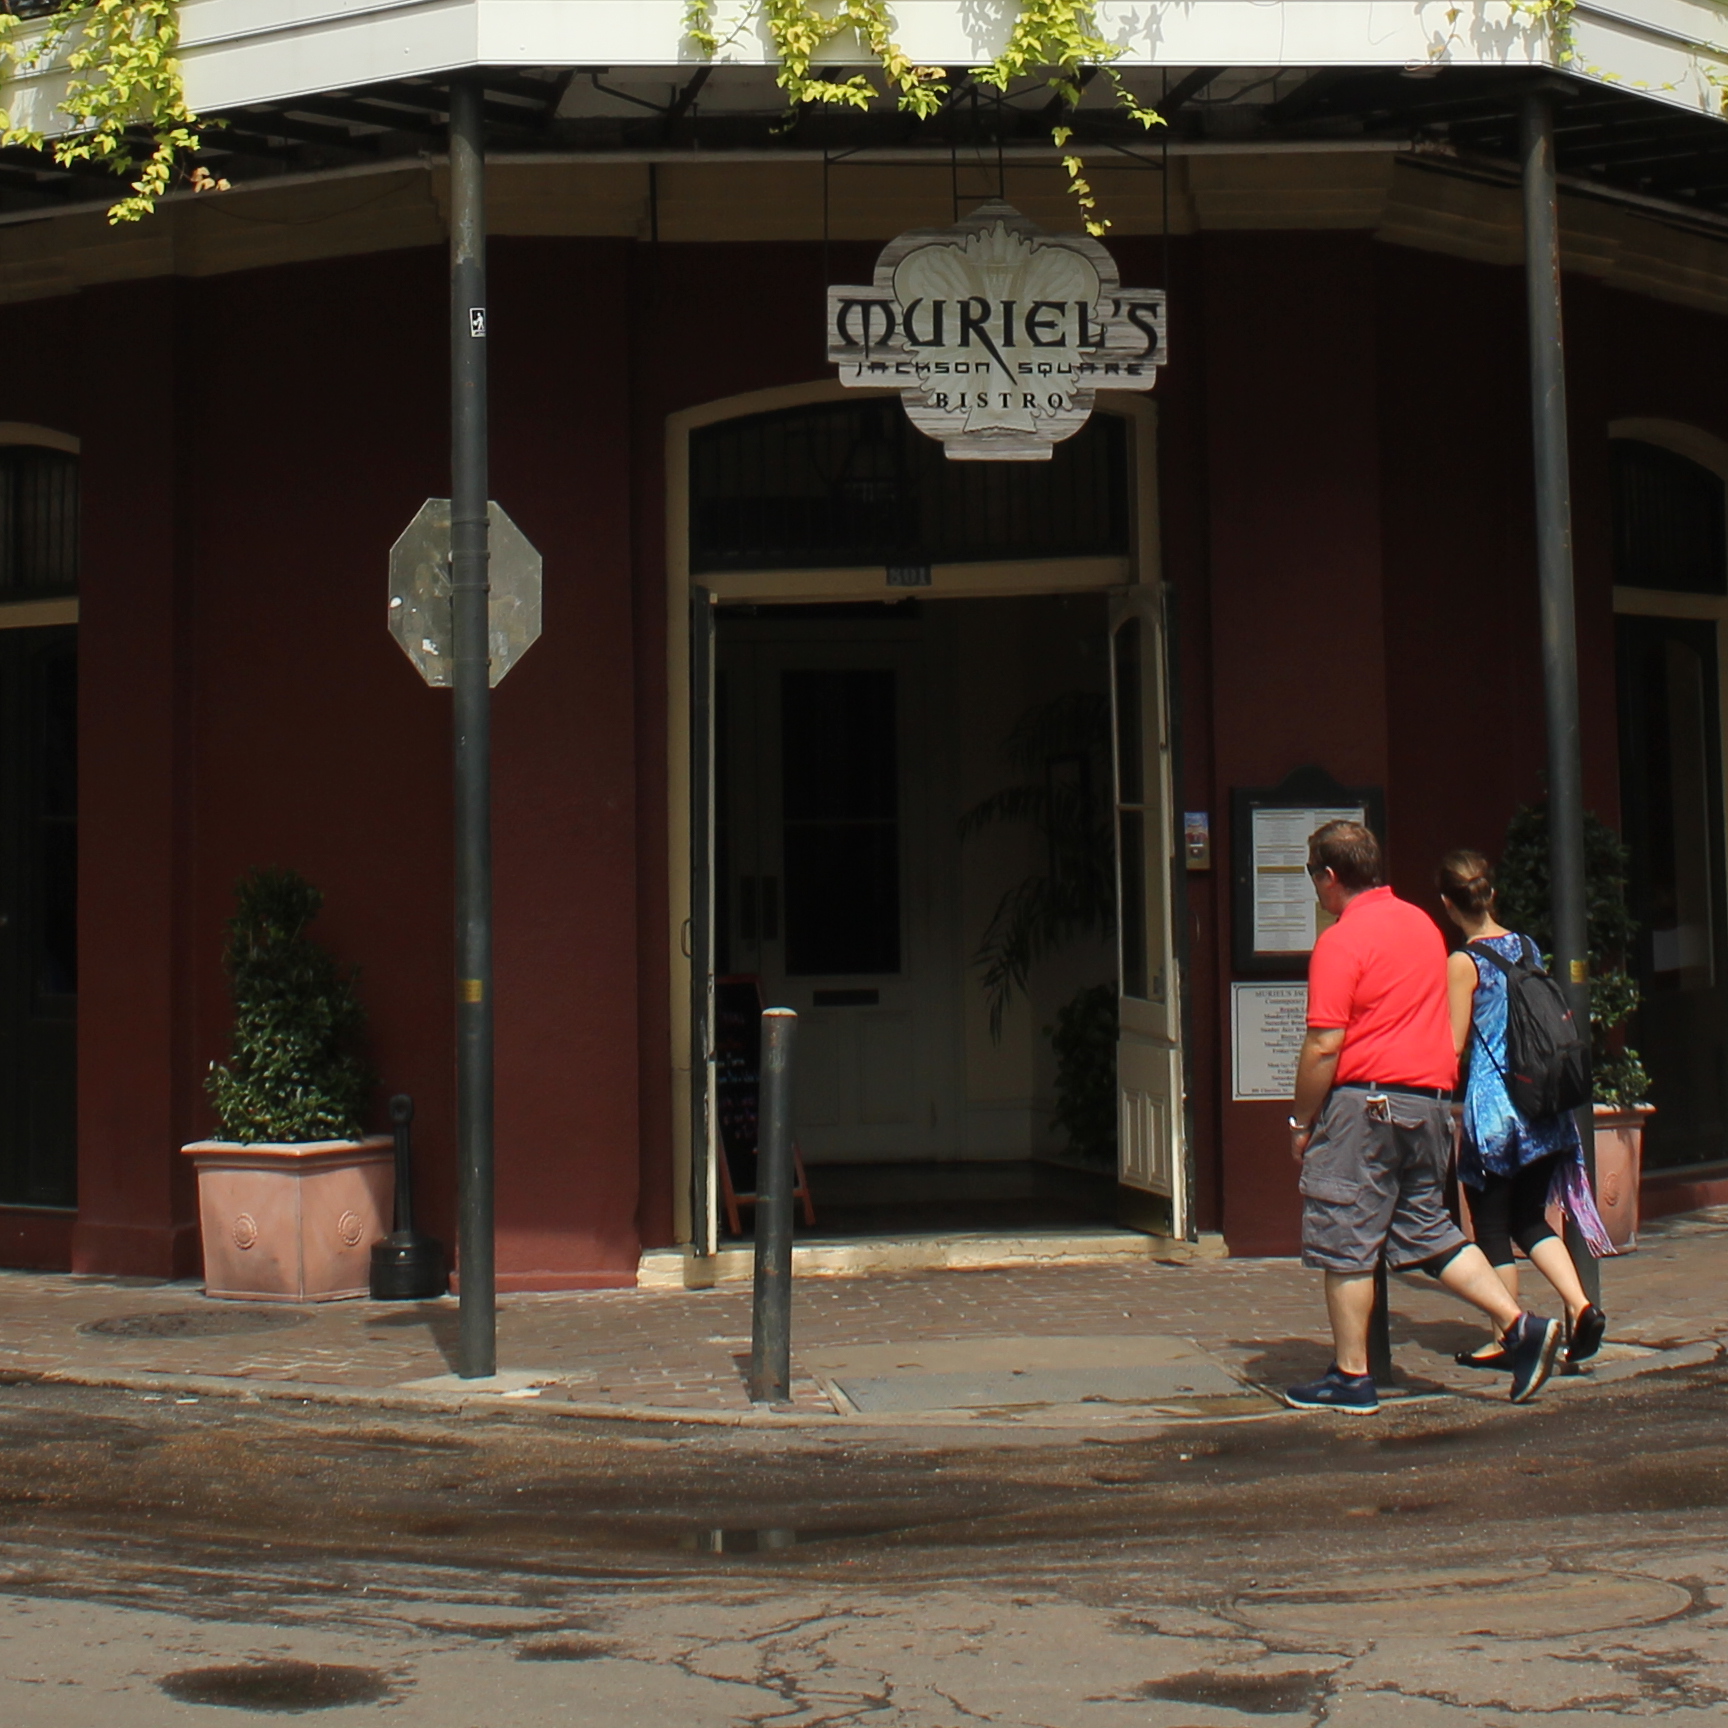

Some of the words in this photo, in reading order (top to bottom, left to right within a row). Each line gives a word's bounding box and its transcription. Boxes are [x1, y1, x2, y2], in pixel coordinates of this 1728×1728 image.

[836, 296, 1160, 387] MURIEL'S
[856, 361, 990, 377] JACKSON
[1017, 362, 1144, 378] SQUARE
[935, 392, 1065, 409] BISTRO
